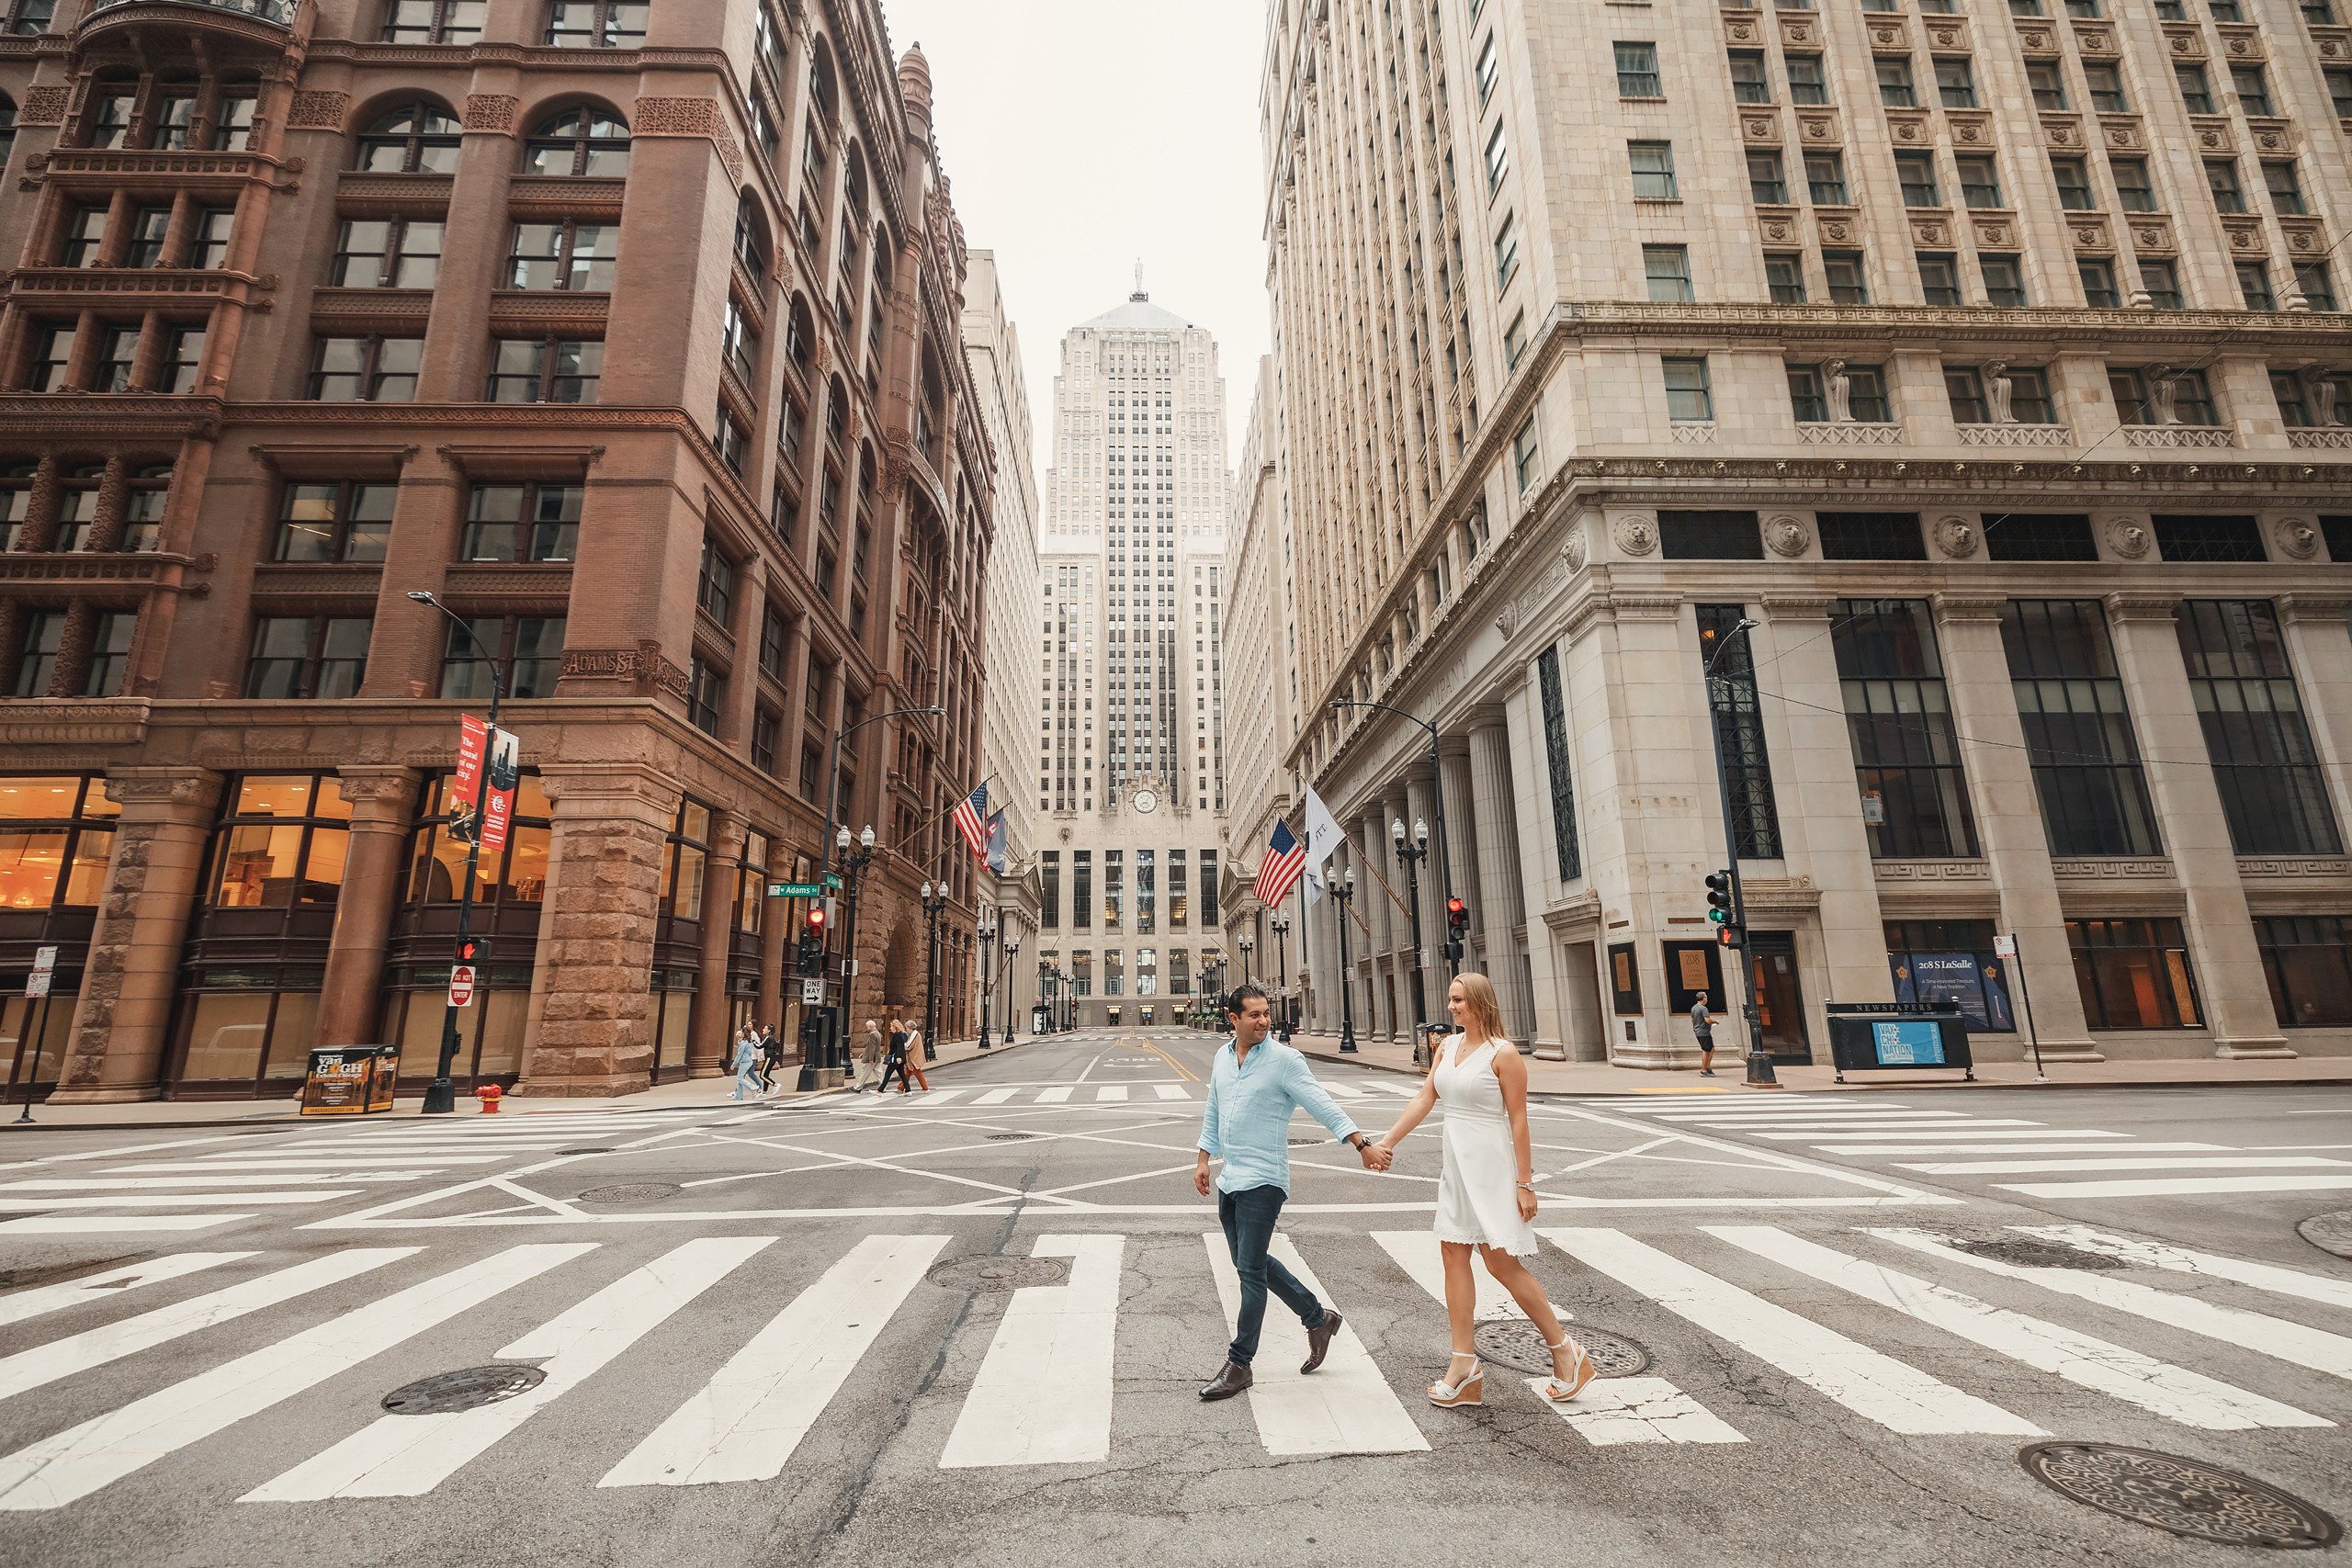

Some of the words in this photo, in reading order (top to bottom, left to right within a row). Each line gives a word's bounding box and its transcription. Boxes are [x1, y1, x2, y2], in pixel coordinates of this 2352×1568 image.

[567, 652, 616, 673] ADAMS
[1418, 652, 1467, 724] COMPANY
[461, 735, 474, 748] The
[1081, 827, 1126, 837] CHICAGO
[1129, 827, 1161, 837] BOARD
[1165, 827, 1177, 836] OF
[1182, 827, 1212, 837] TRADE
[1685, 954, 1701, 964] 208
[1918, 961, 1934, 969] 208
[1934, 961, 1941, 969] S
[1941, 959, 1973, 969] LaSalle
[1879, 1024, 1894, 1035] VAX
[1883, 1045, 1913, 1055] NATION
